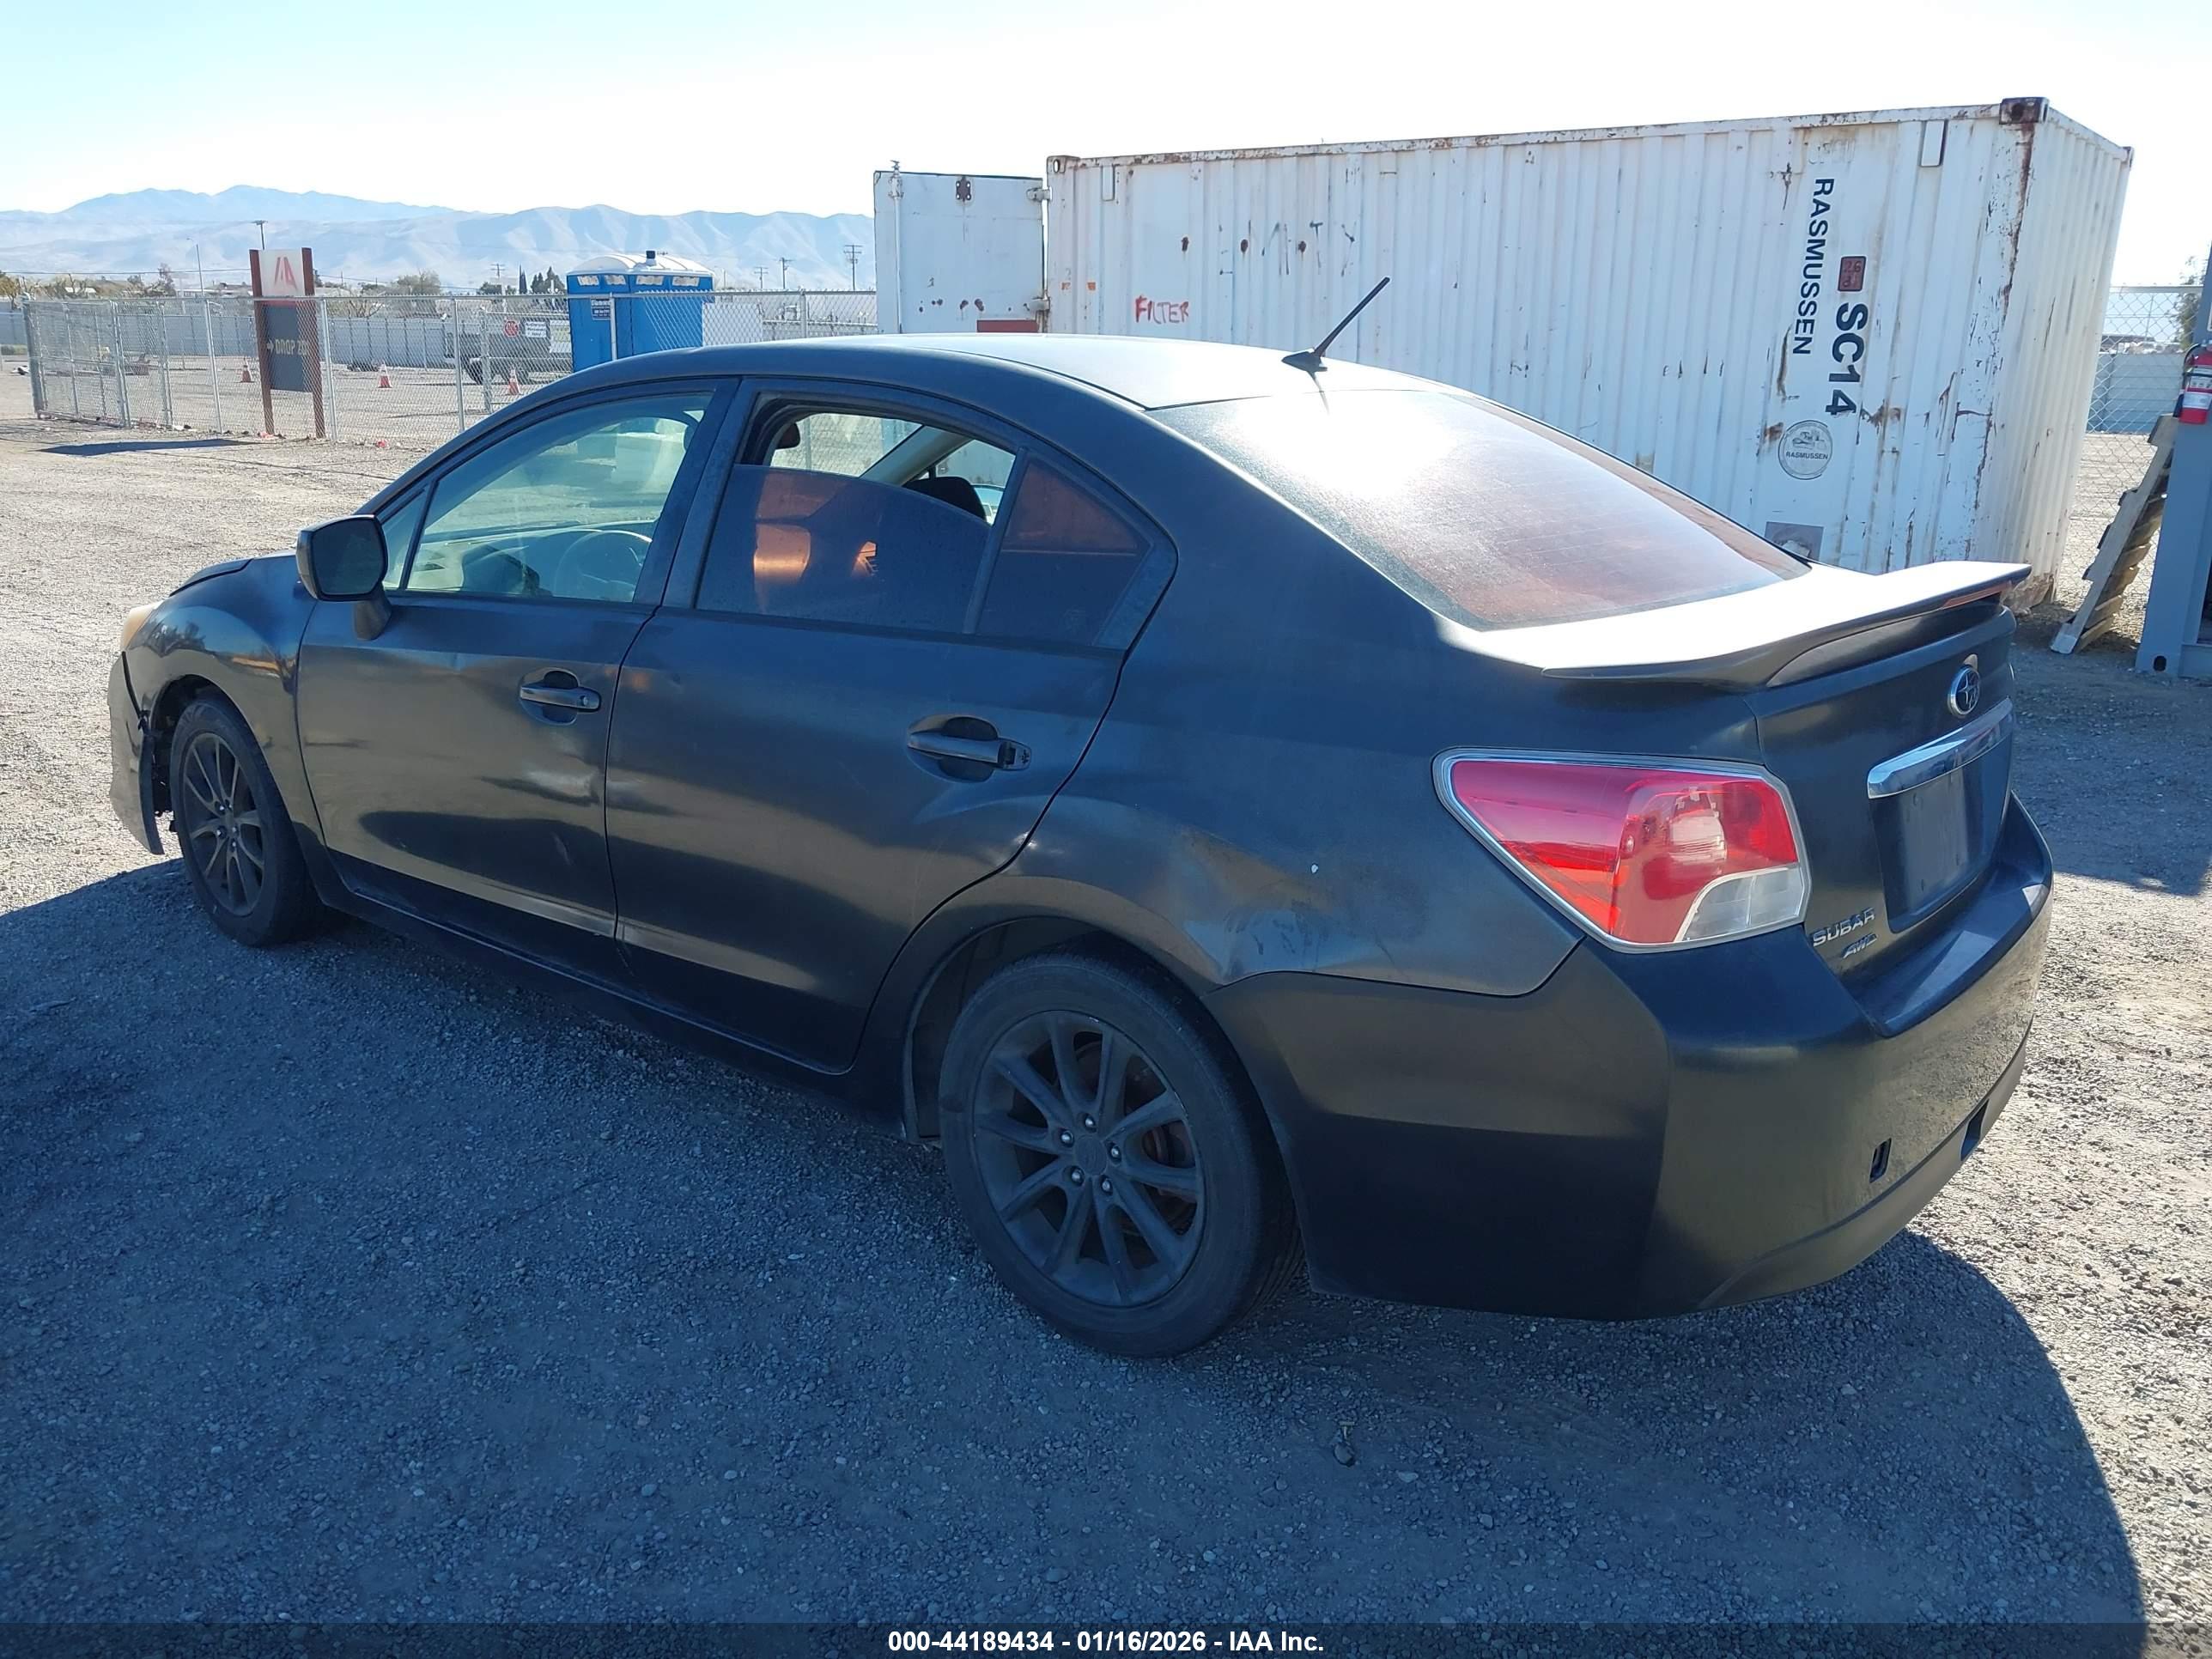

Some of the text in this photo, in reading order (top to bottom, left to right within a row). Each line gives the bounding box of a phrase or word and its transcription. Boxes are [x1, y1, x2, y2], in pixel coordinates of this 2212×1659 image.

[1792, 178, 1834, 355] RASMUSSEN
[1135, 295, 1189, 325] FILTER
[1825, 301, 1869, 416] SC14
[1786, 451, 1828, 459] RASMUSSEN
